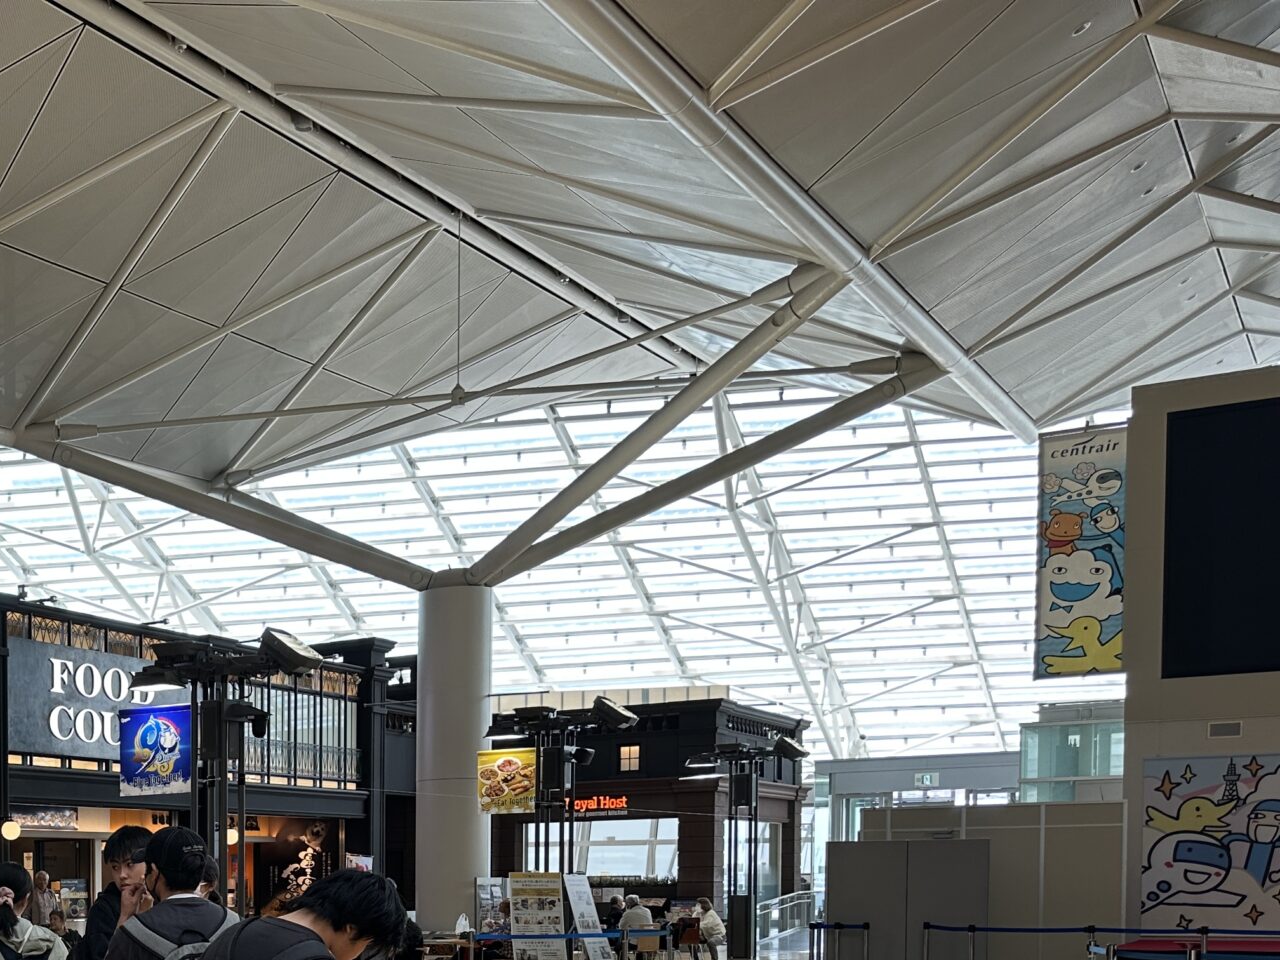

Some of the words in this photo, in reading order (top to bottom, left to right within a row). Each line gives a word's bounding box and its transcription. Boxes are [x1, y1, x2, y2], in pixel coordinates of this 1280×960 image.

[1051, 440, 1119, 458] centrair
[49, 705, 121, 746] COU
[599, 796, 628, 809] Host
